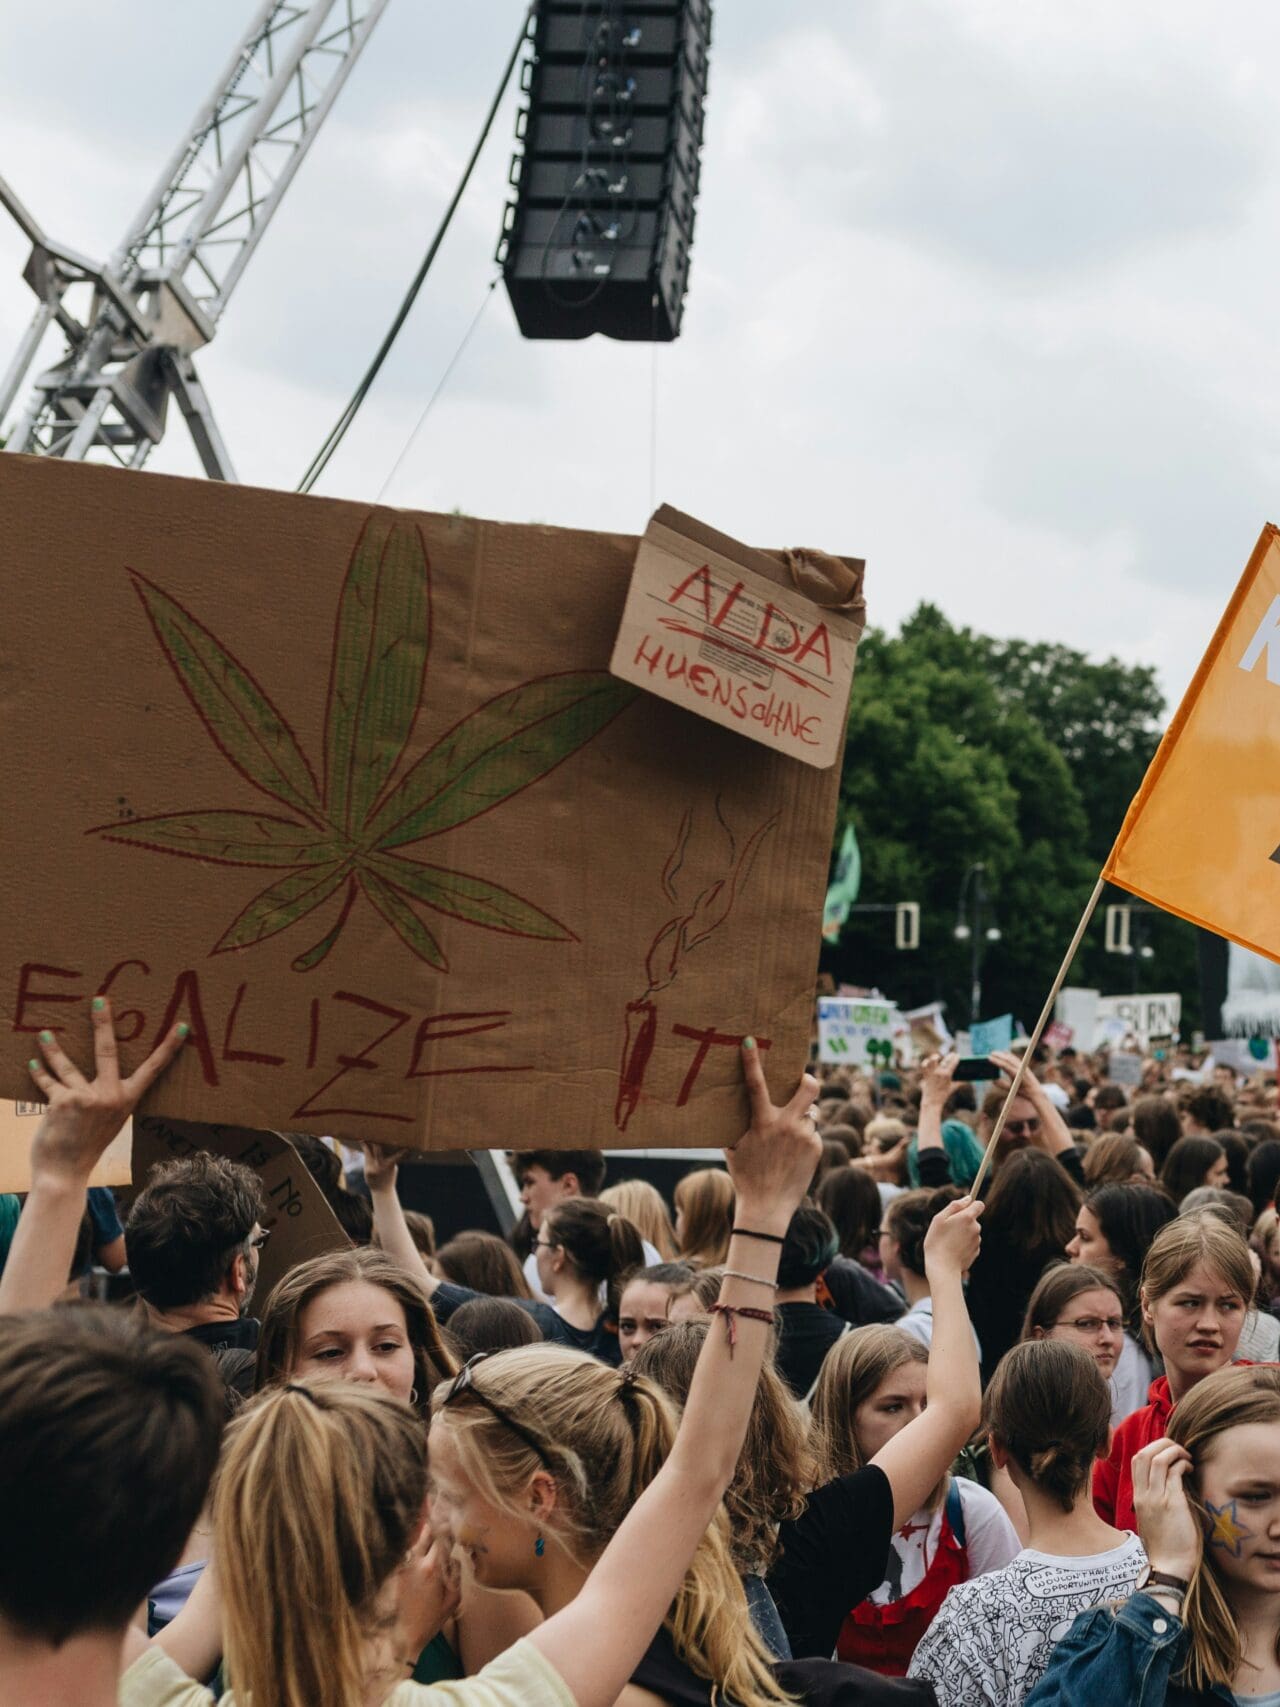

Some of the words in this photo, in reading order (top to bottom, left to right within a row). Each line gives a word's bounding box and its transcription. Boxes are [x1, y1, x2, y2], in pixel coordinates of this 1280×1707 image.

[1088, 1566, 1111, 1577] HAVE
[1042, 1574, 1109, 1595] OPPORTUNITIES
[1111, 1571, 1128, 1581] LIKE
